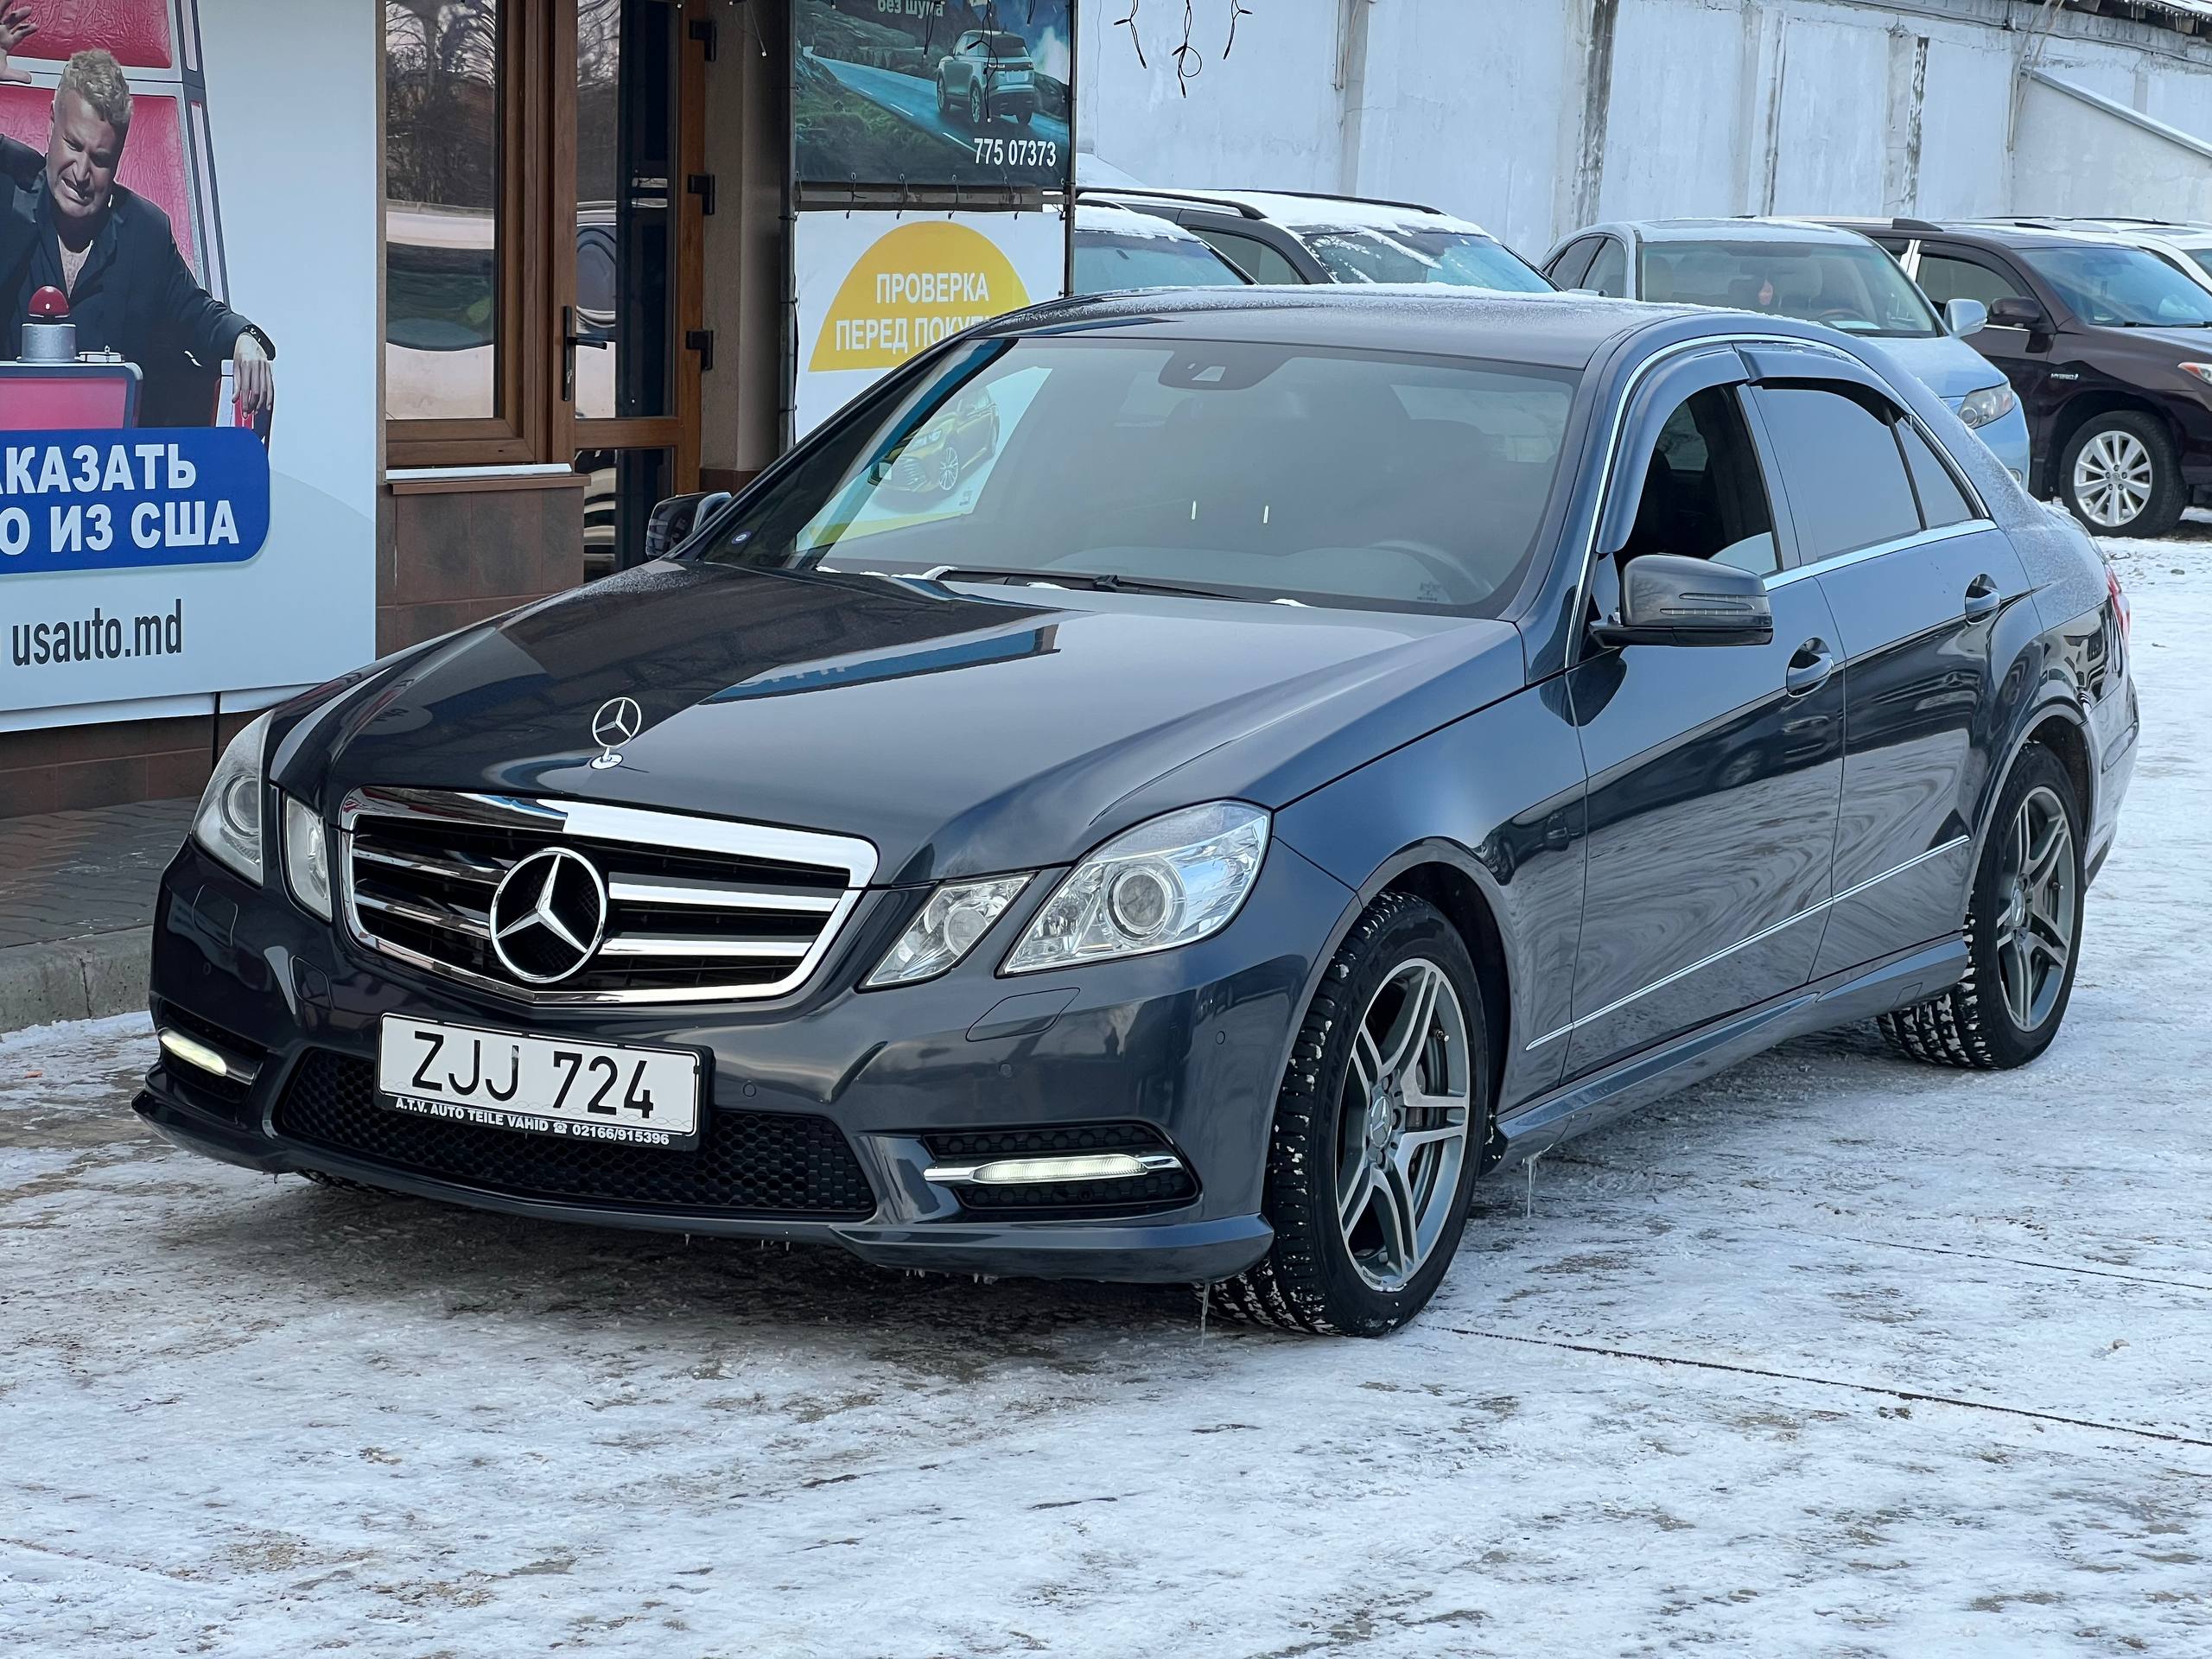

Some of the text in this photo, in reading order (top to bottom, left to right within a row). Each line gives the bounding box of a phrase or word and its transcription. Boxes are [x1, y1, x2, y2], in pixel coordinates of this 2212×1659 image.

[974, 137, 1057, 167] 775 07373
[876, 272, 989, 303] ПРОВЕРКА
[836, 318, 907, 354] ПЕРЕД
[0, 443, 197, 494] КАЗАТЬ
[50, 504, 113, 553] ИЗ
[130, 499, 240, 549] США
[12, 598, 182, 666] usauto.md
[411, 1030, 654, 1119] ZJJ 724
[396, 1097, 670, 1146] A.T.V. AUTO TEILE VAHID 02166/915396
